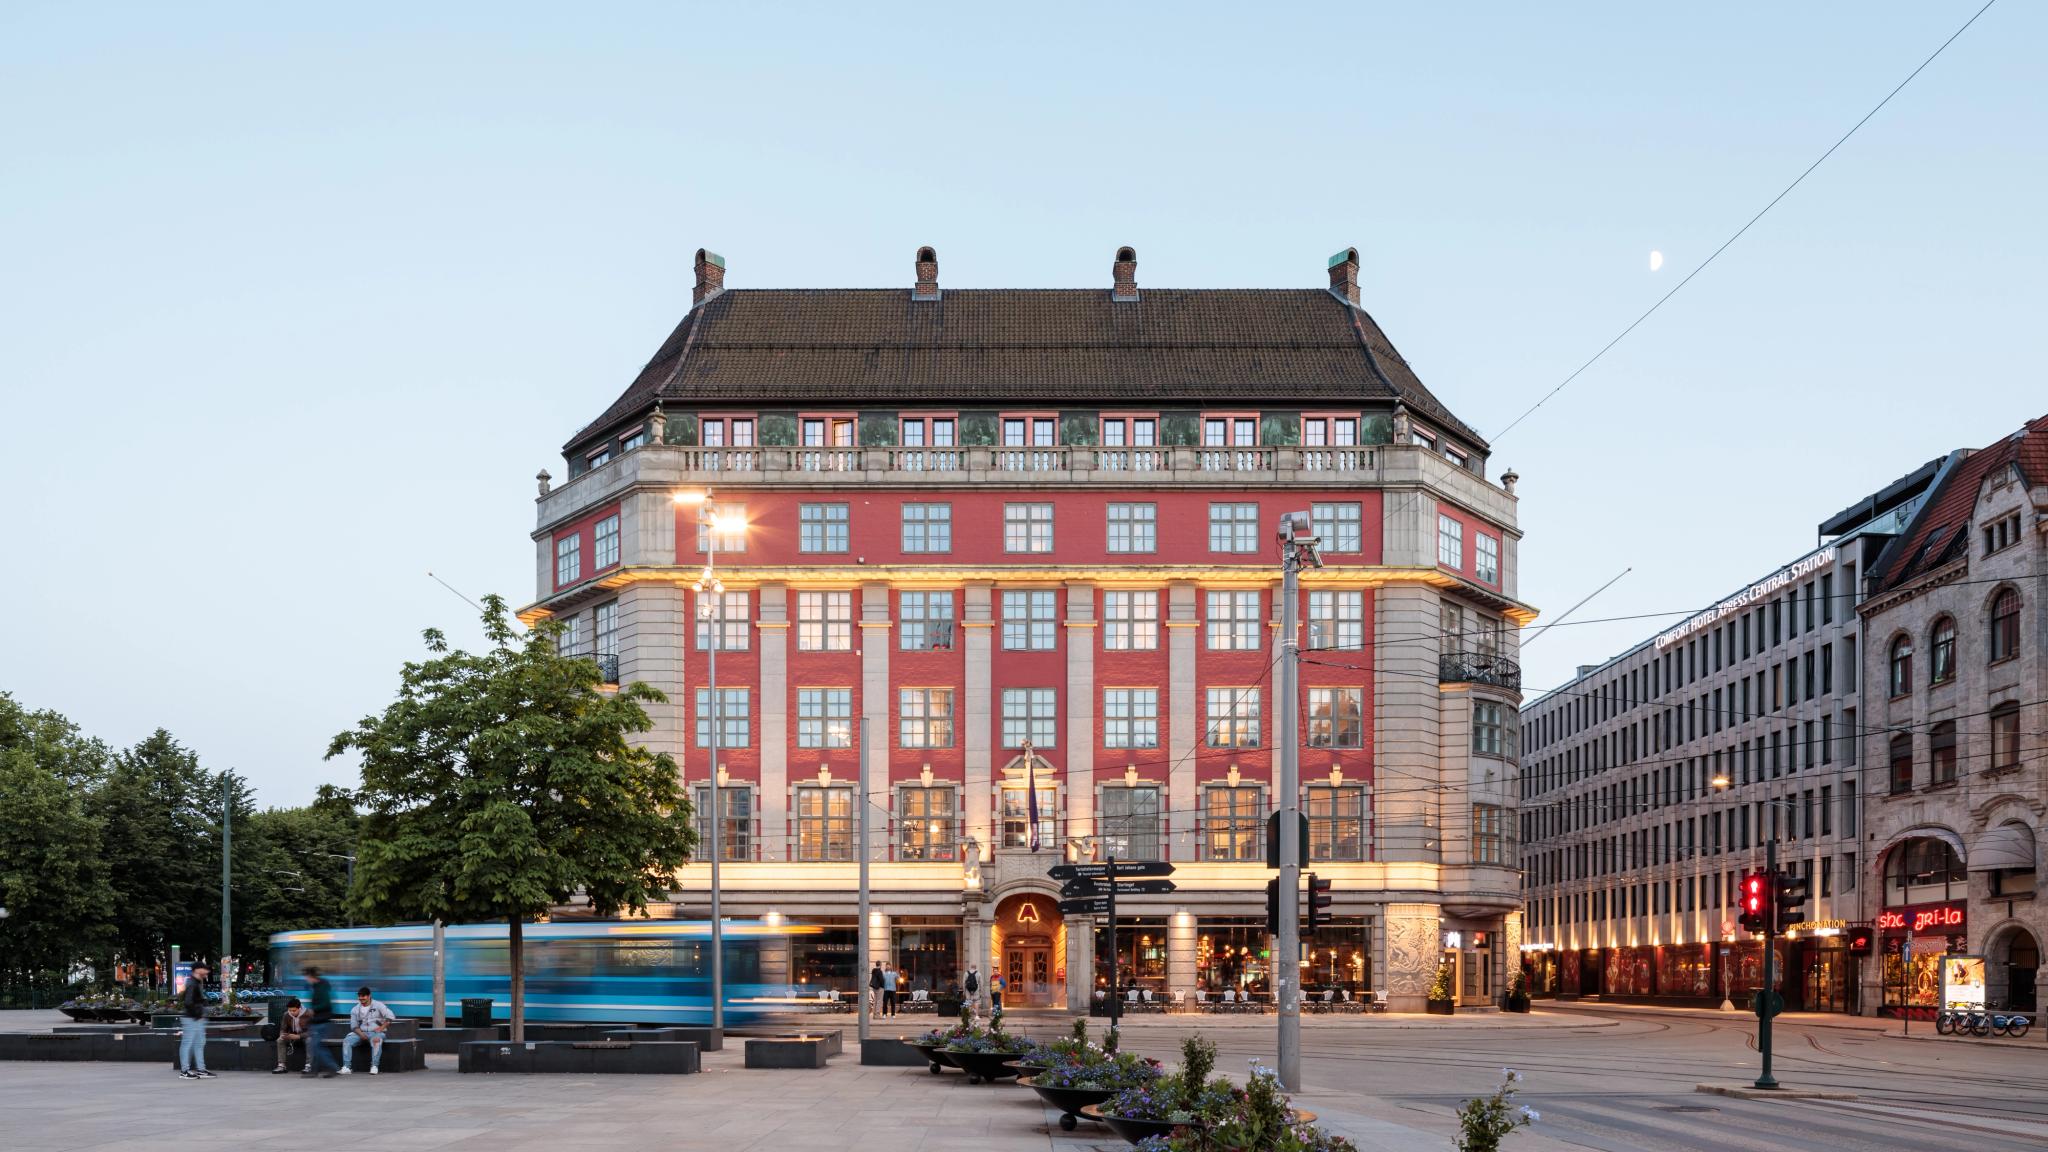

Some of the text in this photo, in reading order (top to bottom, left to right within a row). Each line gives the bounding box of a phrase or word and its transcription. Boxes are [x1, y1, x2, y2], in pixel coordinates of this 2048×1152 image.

[1655, 547, 1835, 649] COMFORT HOTEL XPRESS CENTRAL STATION
[1017, 902, 1039, 922] A
